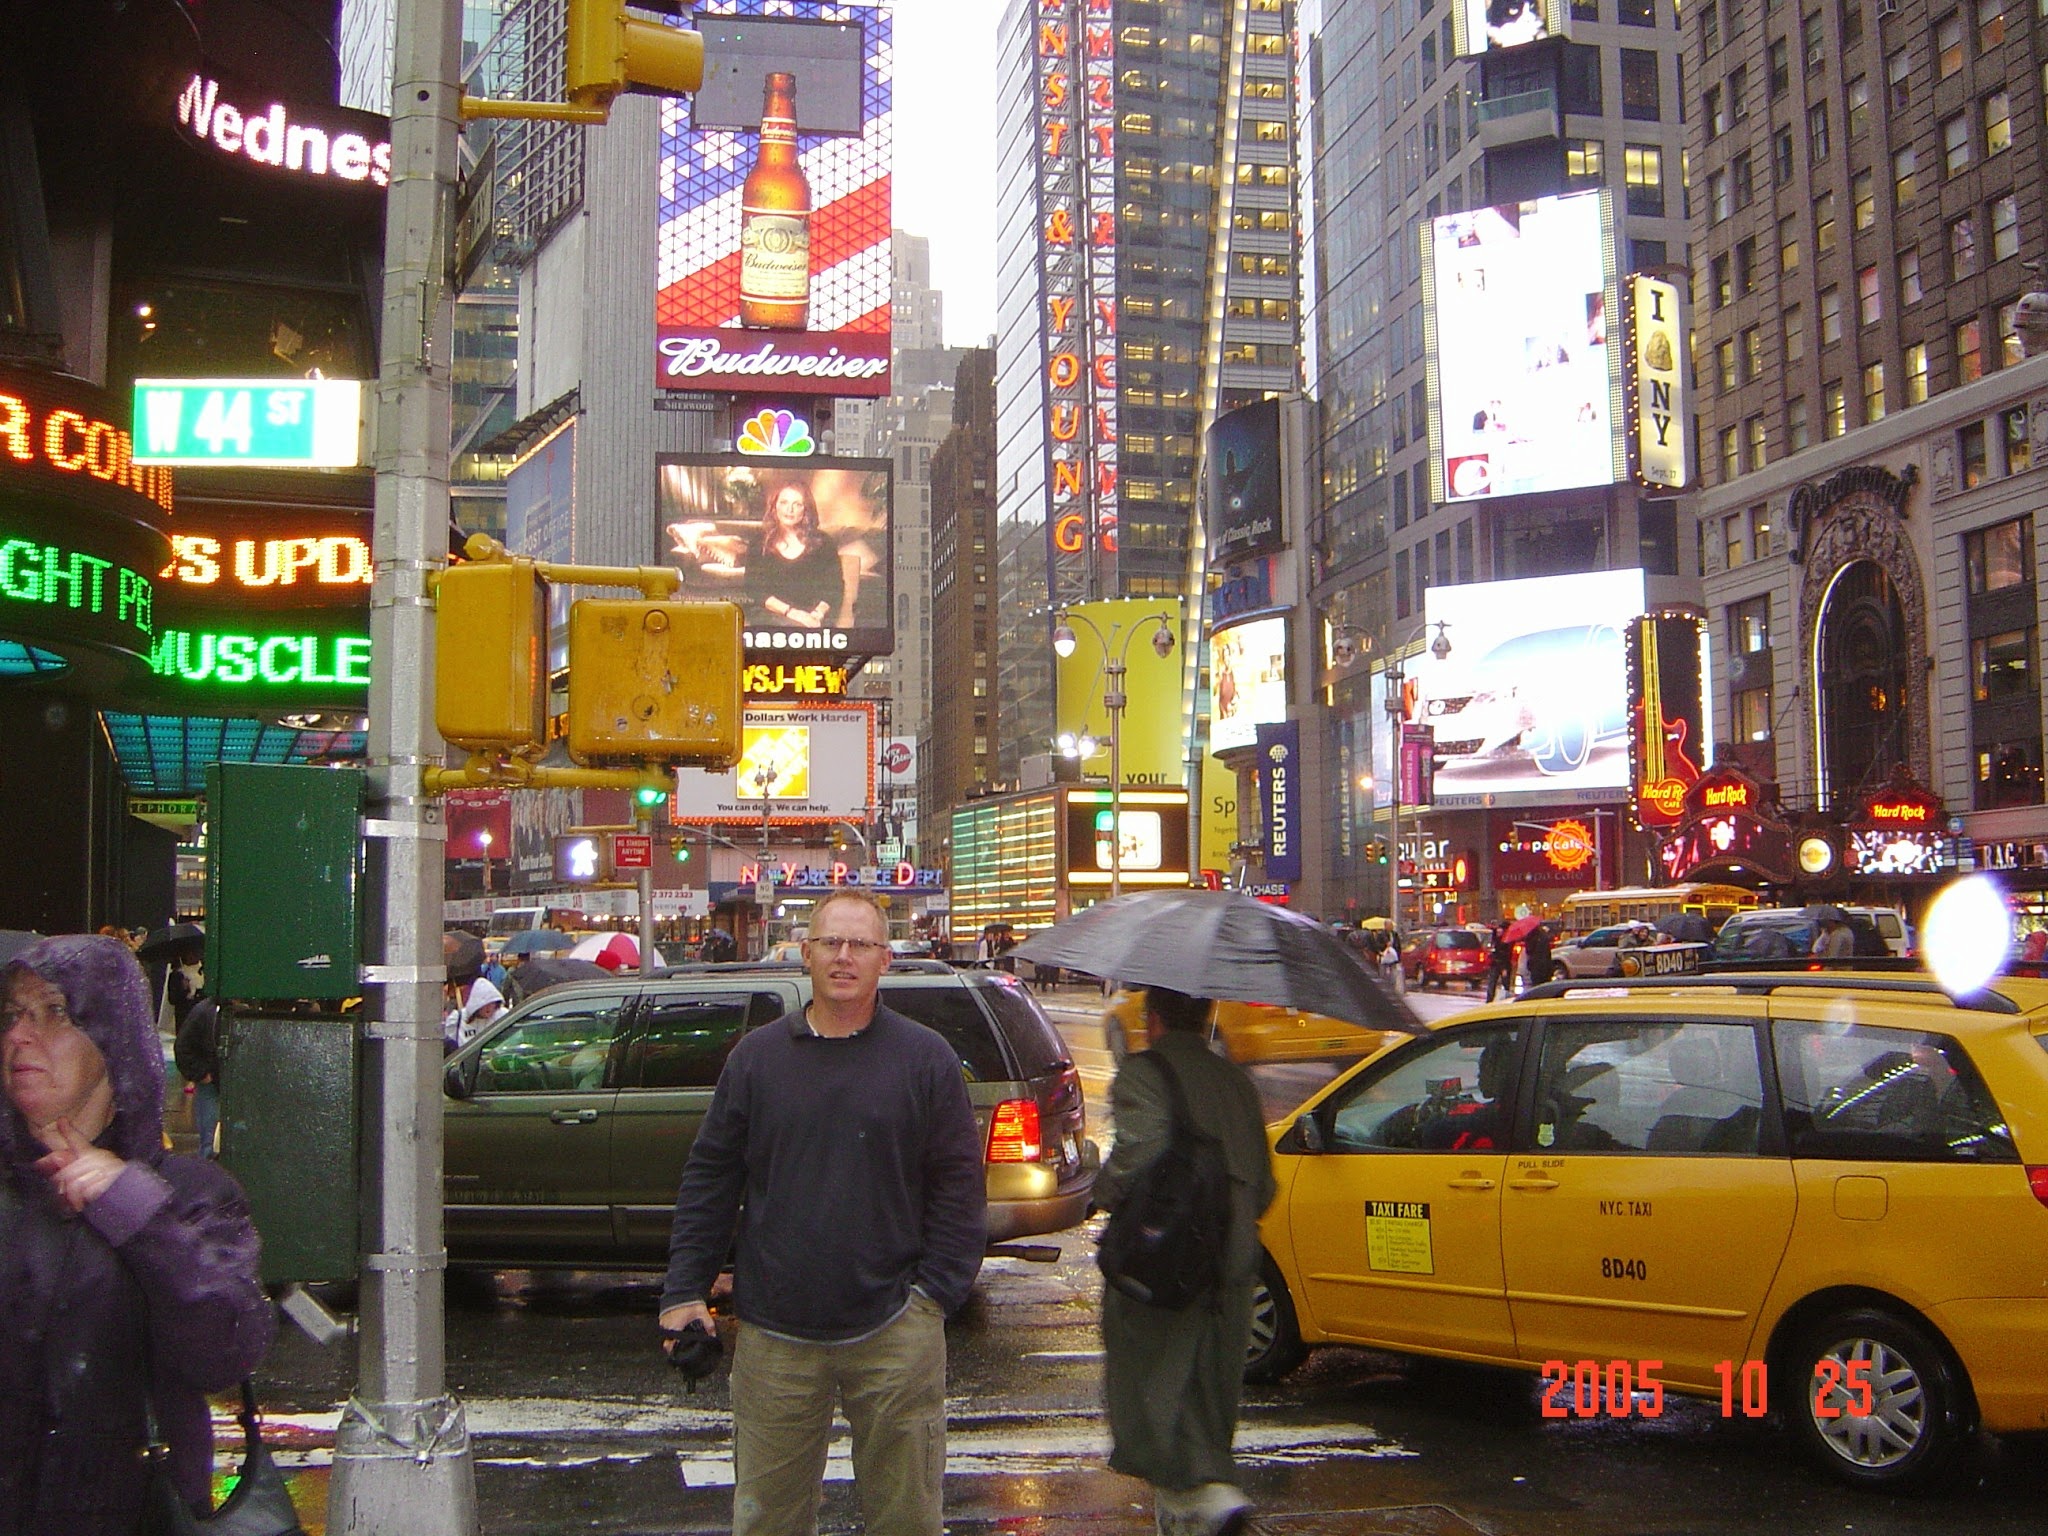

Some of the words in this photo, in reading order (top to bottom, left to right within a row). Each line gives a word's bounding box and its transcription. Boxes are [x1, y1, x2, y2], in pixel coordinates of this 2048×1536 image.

[1039, 0, 1070, 156] NST
[1046, 210, 1073, 244] &
[745, 254, 807, 271] Budweiser
[658, 337, 889, 379] Budweiser
[145, 390, 183, 454] W
[194, 390, 252, 454] 44
[268, 390, 306, 426] ST
[1050, 297, 1083, 552] YOUNG
[120, 567, 153, 635] PE
[151, 630, 372, 684] MUSCLE
[745, 713, 785, 722] Dollars
[787, 713, 818, 722] Work
[821, 713, 862, 723] Harder
[1126, 772, 1168, 785] your
[1643, 785, 1672, 799] Hard
[1706, 786, 1727, 806] Hard
[1727, 784, 1747, 807] Rock
[717, 803, 733, 812] You
[734, 804, 750, 812] can
[777, 803, 790, 812] We
[792, 804, 808, 812] can
[1273, 767, 1286, 856] REUTERS
[1874, 805, 1899, 818] Hard
[1901, 805, 1925, 820] Rock
[1398, 840, 1450, 861] guar
[1499, 841, 1551, 853] eropa
[833, 862, 891, 886] POCE
[1252, 884, 1285, 896] CHASE
[1656, 952, 1683, 974] 8D40
[1371, 1202, 1395, 1216] TAXI
[1397, 1203, 1424, 1218] FARE
[1629, 1201, 1652, 1216] TAXI
[1602, 1257, 1647, 1280] 8D40
